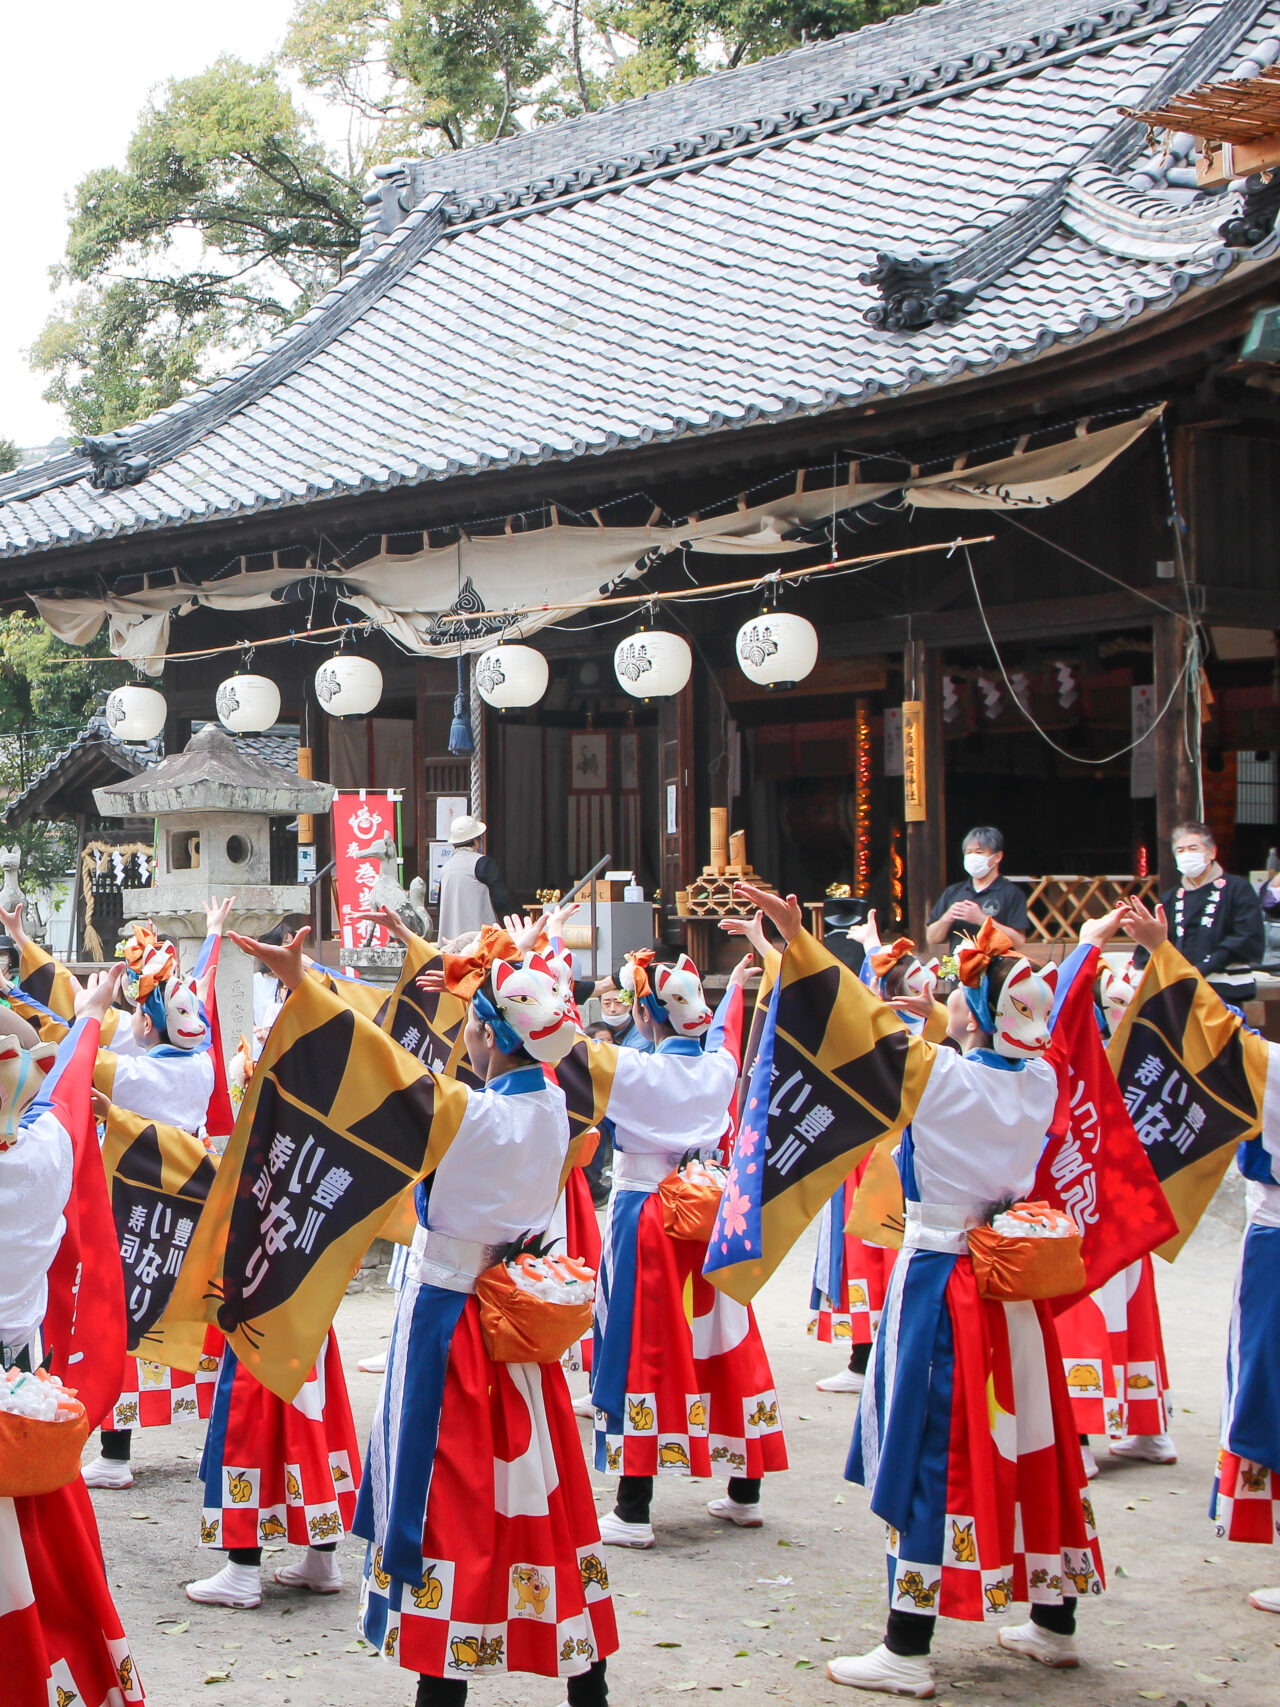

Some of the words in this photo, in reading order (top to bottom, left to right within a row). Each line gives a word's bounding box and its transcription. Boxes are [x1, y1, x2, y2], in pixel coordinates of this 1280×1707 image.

[767, 1104, 836, 1177] 豊川
[1134, 1069, 1188, 1146] いな
[1169, 1101, 1207, 1155] 豊川
[252, 1132, 296, 1211] 寿司
[293, 1166, 354, 1254] 豊川
[119, 1204, 148, 1264] 寿司
[162, 1217, 194, 1278] 豊川
[242, 1134, 326, 1299] いなり
[129, 1201, 172, 1323] いなり
